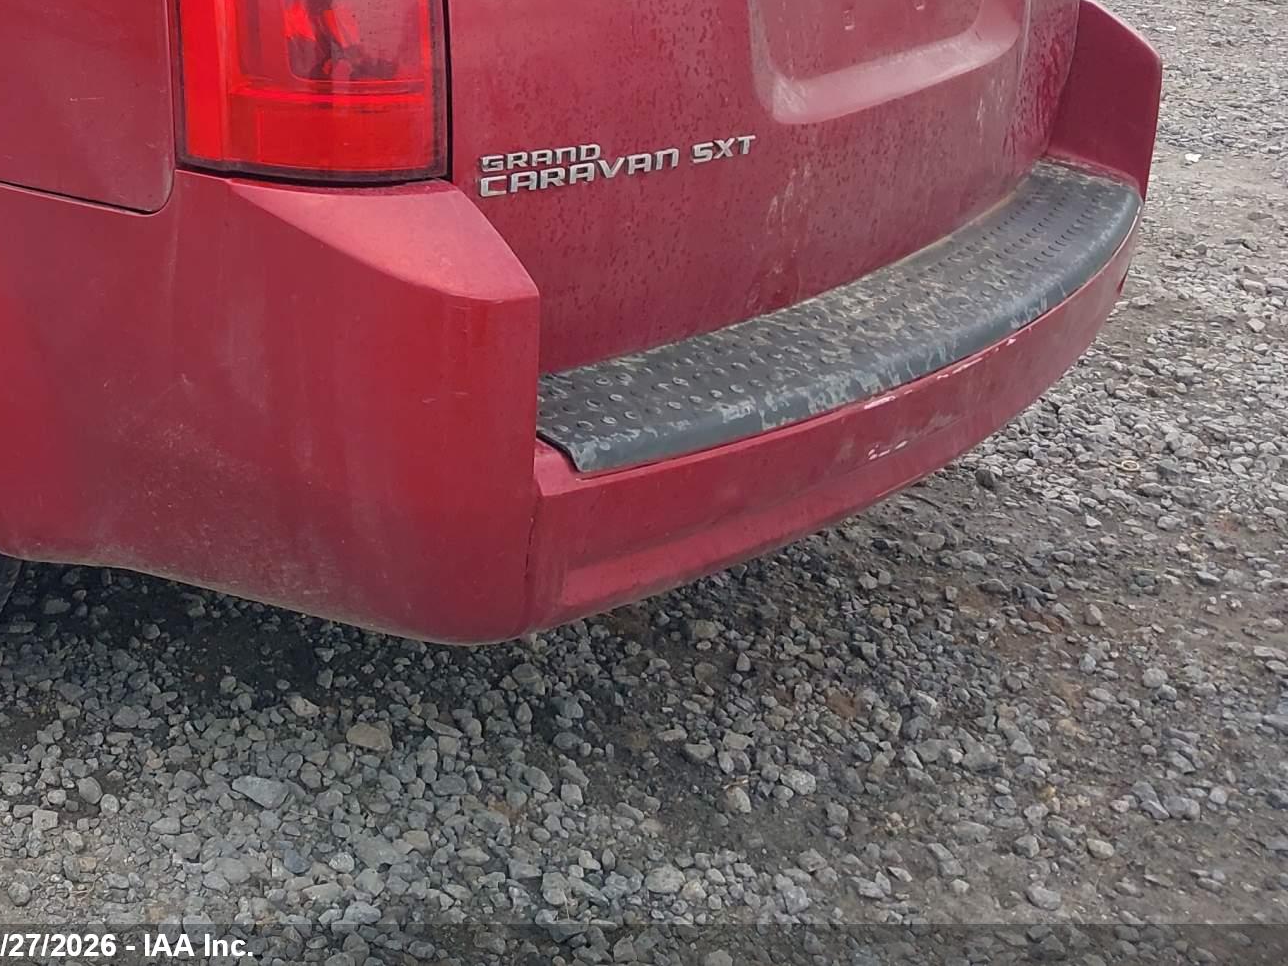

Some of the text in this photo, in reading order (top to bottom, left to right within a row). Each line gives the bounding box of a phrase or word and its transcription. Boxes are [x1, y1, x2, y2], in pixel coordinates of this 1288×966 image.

[480, 143, 601, 172] GRAND
[480, 135, 756, 197] CARAVAN SXT
